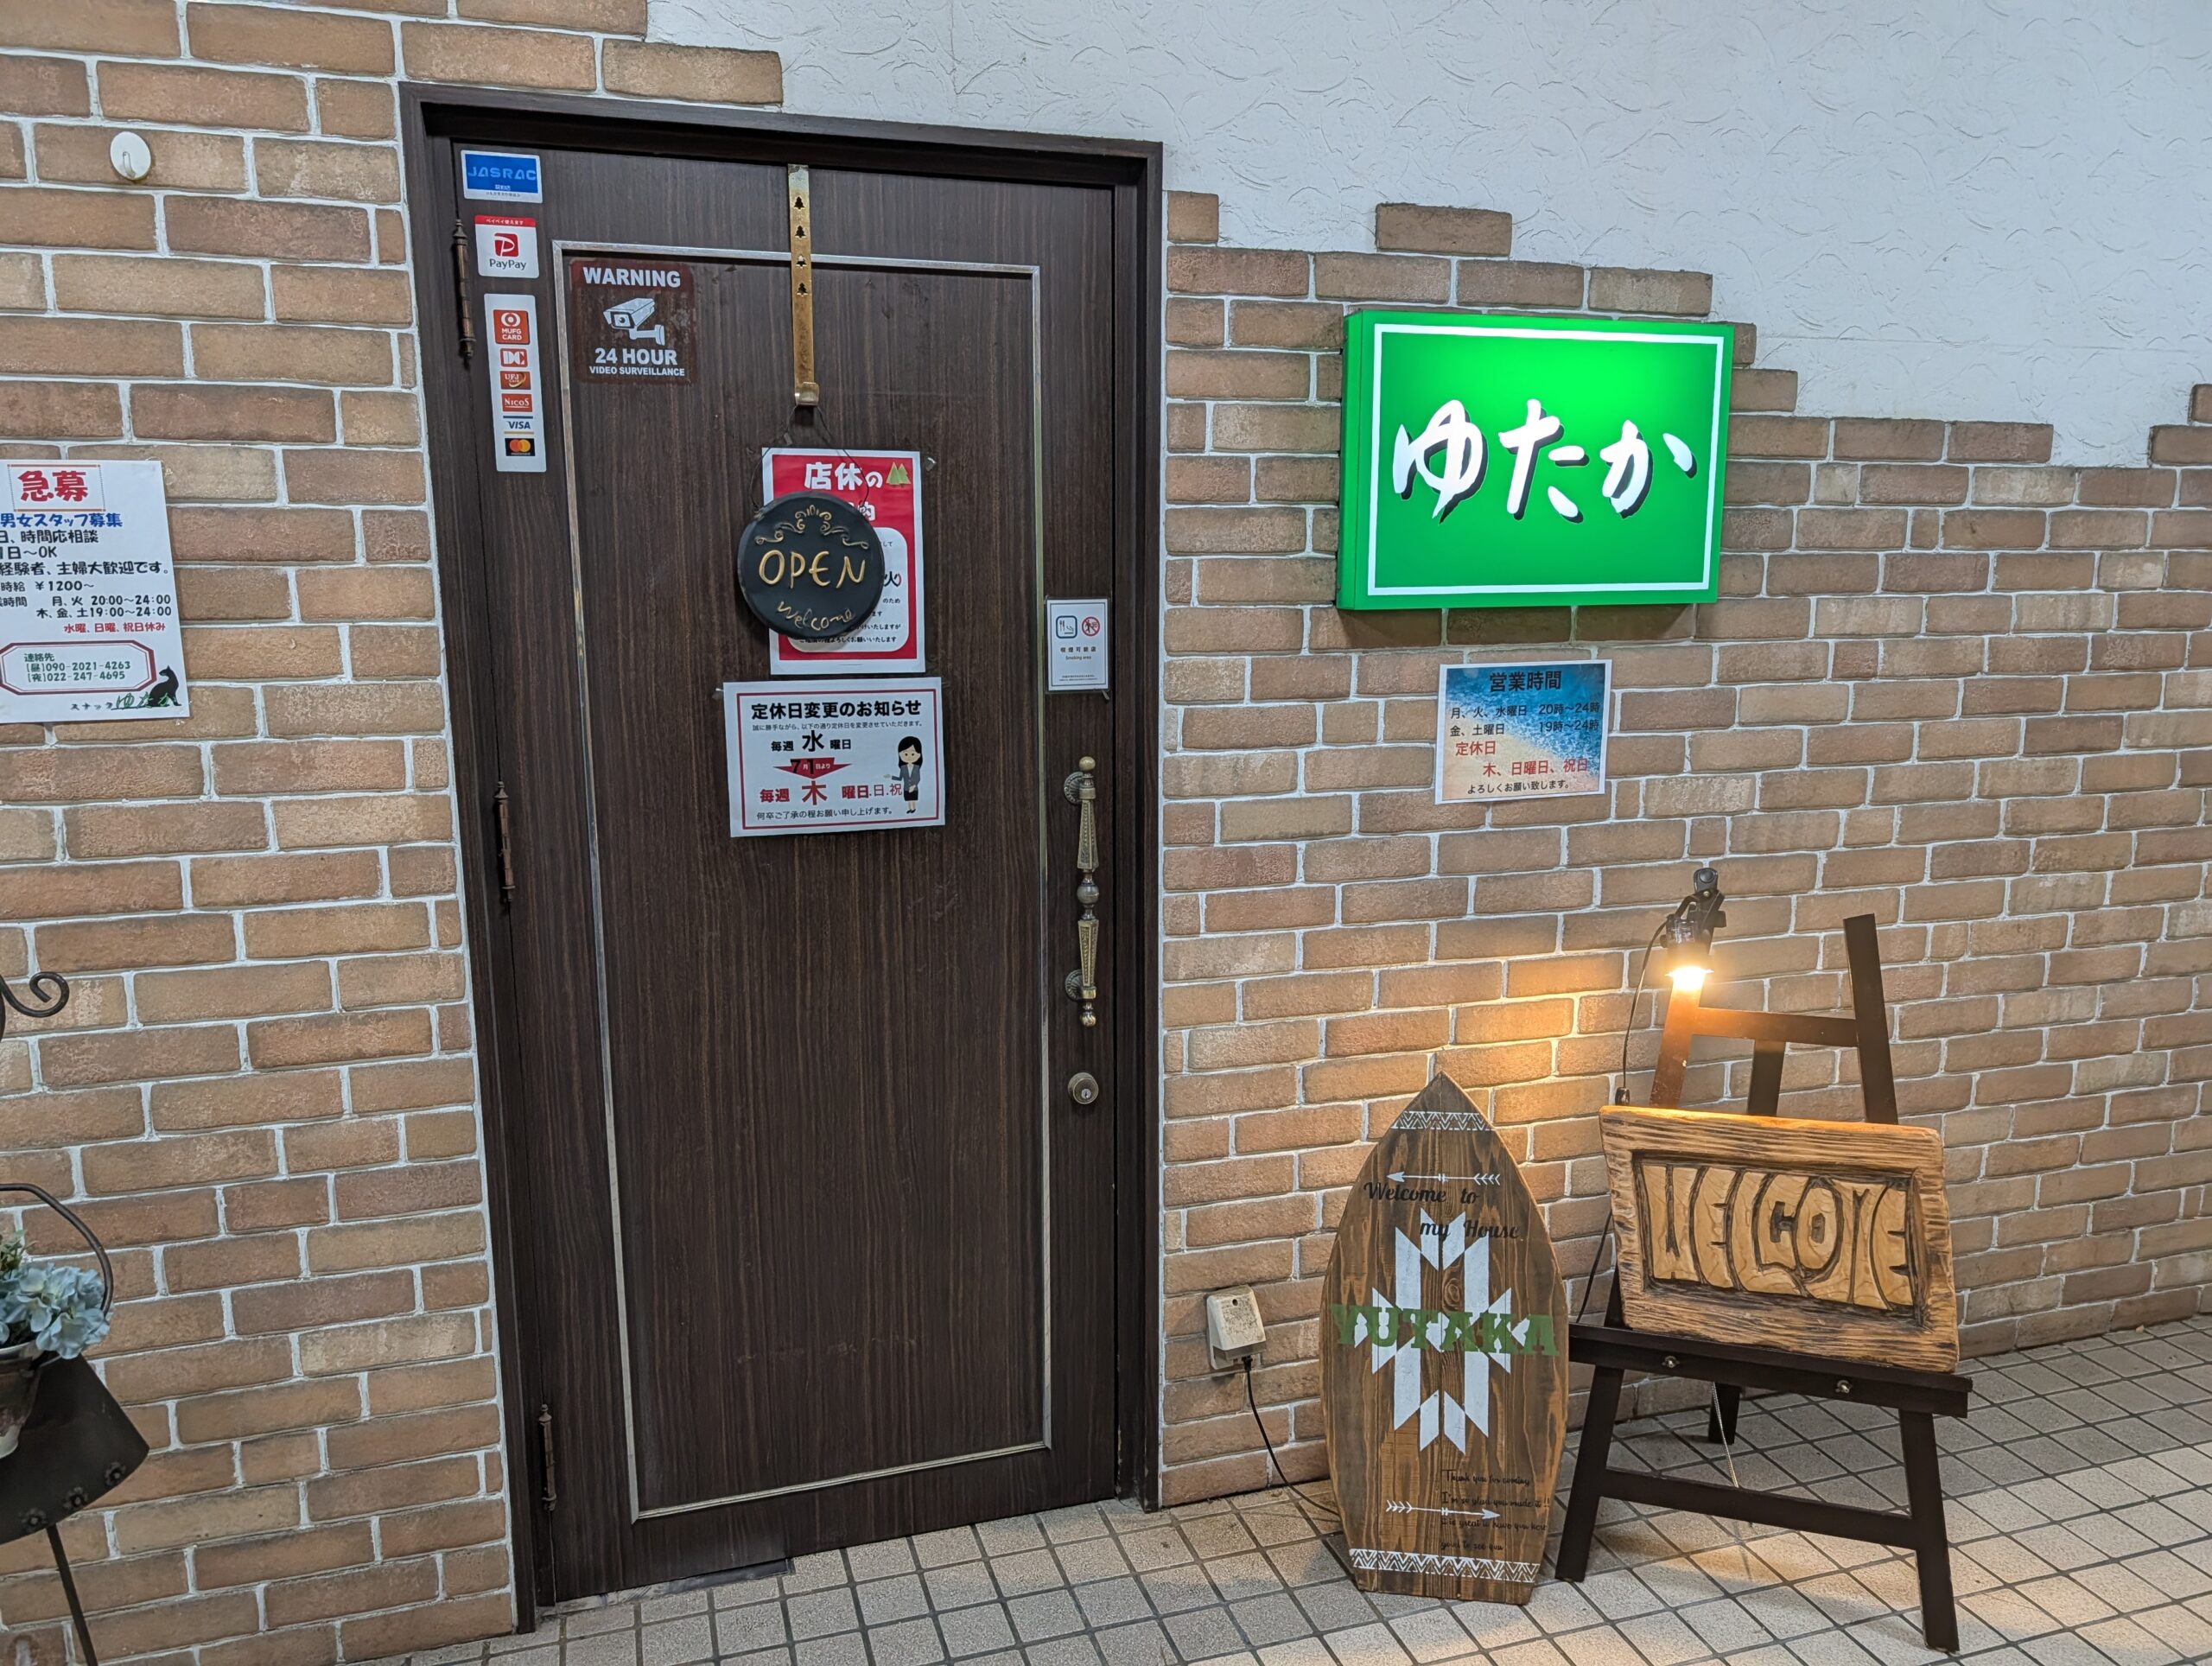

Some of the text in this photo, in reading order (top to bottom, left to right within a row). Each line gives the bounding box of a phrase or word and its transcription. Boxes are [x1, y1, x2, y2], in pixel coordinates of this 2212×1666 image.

[467, 166, 537, 181] JASRAC
[489, 258, 527, 271] PayPay
[582, 266, 681, 288] WARNING
[594, 347, 678, 366] 24 HOUR
[589, 366, 685, 377] VIDEO SURVEILLANCE
[506, 421, 531, 429] VISA
[1392, 398, 1698, 525] ゆたか
[804, 461, 884, 491] 店休の
[17, 469, 89, 503] 急募
[0, 512, 124, 528] 男女スタッフ募集
[758, 550, 866, 589] OPEN
[1, 581, 26, 593] 時給
[0, 596, 28, 607] 時間
[24, 652, 55, 663] 連絡先
[1489, 671, 1562, 693] 営業時間
[751, 700, 922, 721] 定休日変更のお知らせ
[1450, 704, 1528, 720] 月、火、水曜日
[1450, 723, 1505, 737] 金、土曜日
[771, 730, 852, 753] 毎週 水 曜日
[1455, 741, 1497, 756] 定休日
[1483, 758, 1589, 778] 木、日曜日、祝日
[760, 788, 791, 804] 毎週
[801, 780, 828, 805] 木
[1467, 779, 1569, 795] よろしくお願い致します。
[756, 807, 893, 821] 何卒ご了承の程お願い申し上げます。
[1363, 1181, 1480, 1205] Welcome to
[1419, 1219, 1521, 1242] my House
[1641, 1164, 1914, 1311] WELCOME
[1328, 1303, 1560, 1356] YUTAKA
